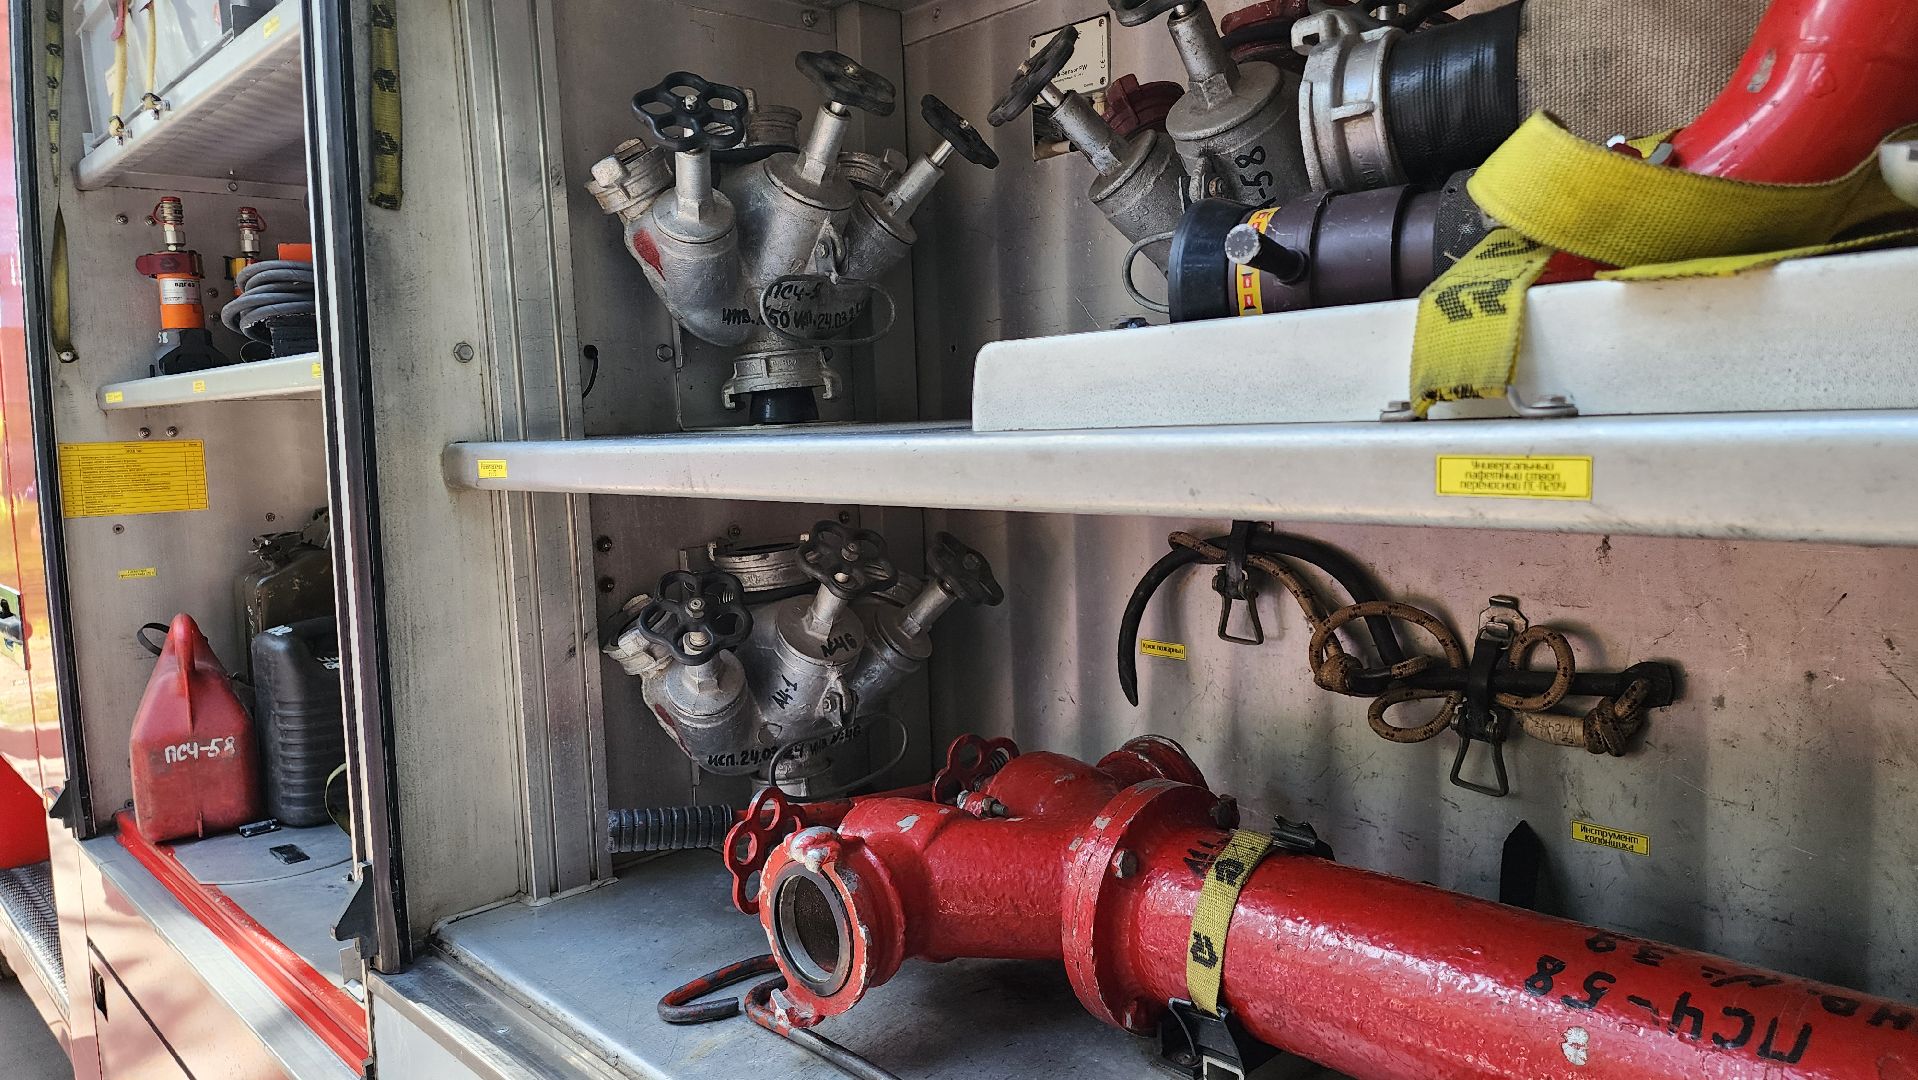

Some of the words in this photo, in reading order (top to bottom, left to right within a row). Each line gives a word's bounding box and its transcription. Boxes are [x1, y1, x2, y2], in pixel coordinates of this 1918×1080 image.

[1471, 460, 1554, 472] Универсальный
[1465, 470, 1522, 482] лафетный
[1525, 472, 1561, 481] ствол
[1460, 480, 1521, 492] переносной
[1142, 642, 1156, 650] Крюк
[164, 735, 236, 764] ПСЧ-58
[1580, 824, 1639, 844] Инструмент
[1584, 834, 1634, 851] колонщика
[1524, 954, 1814, 1064] ПСЧ-58
